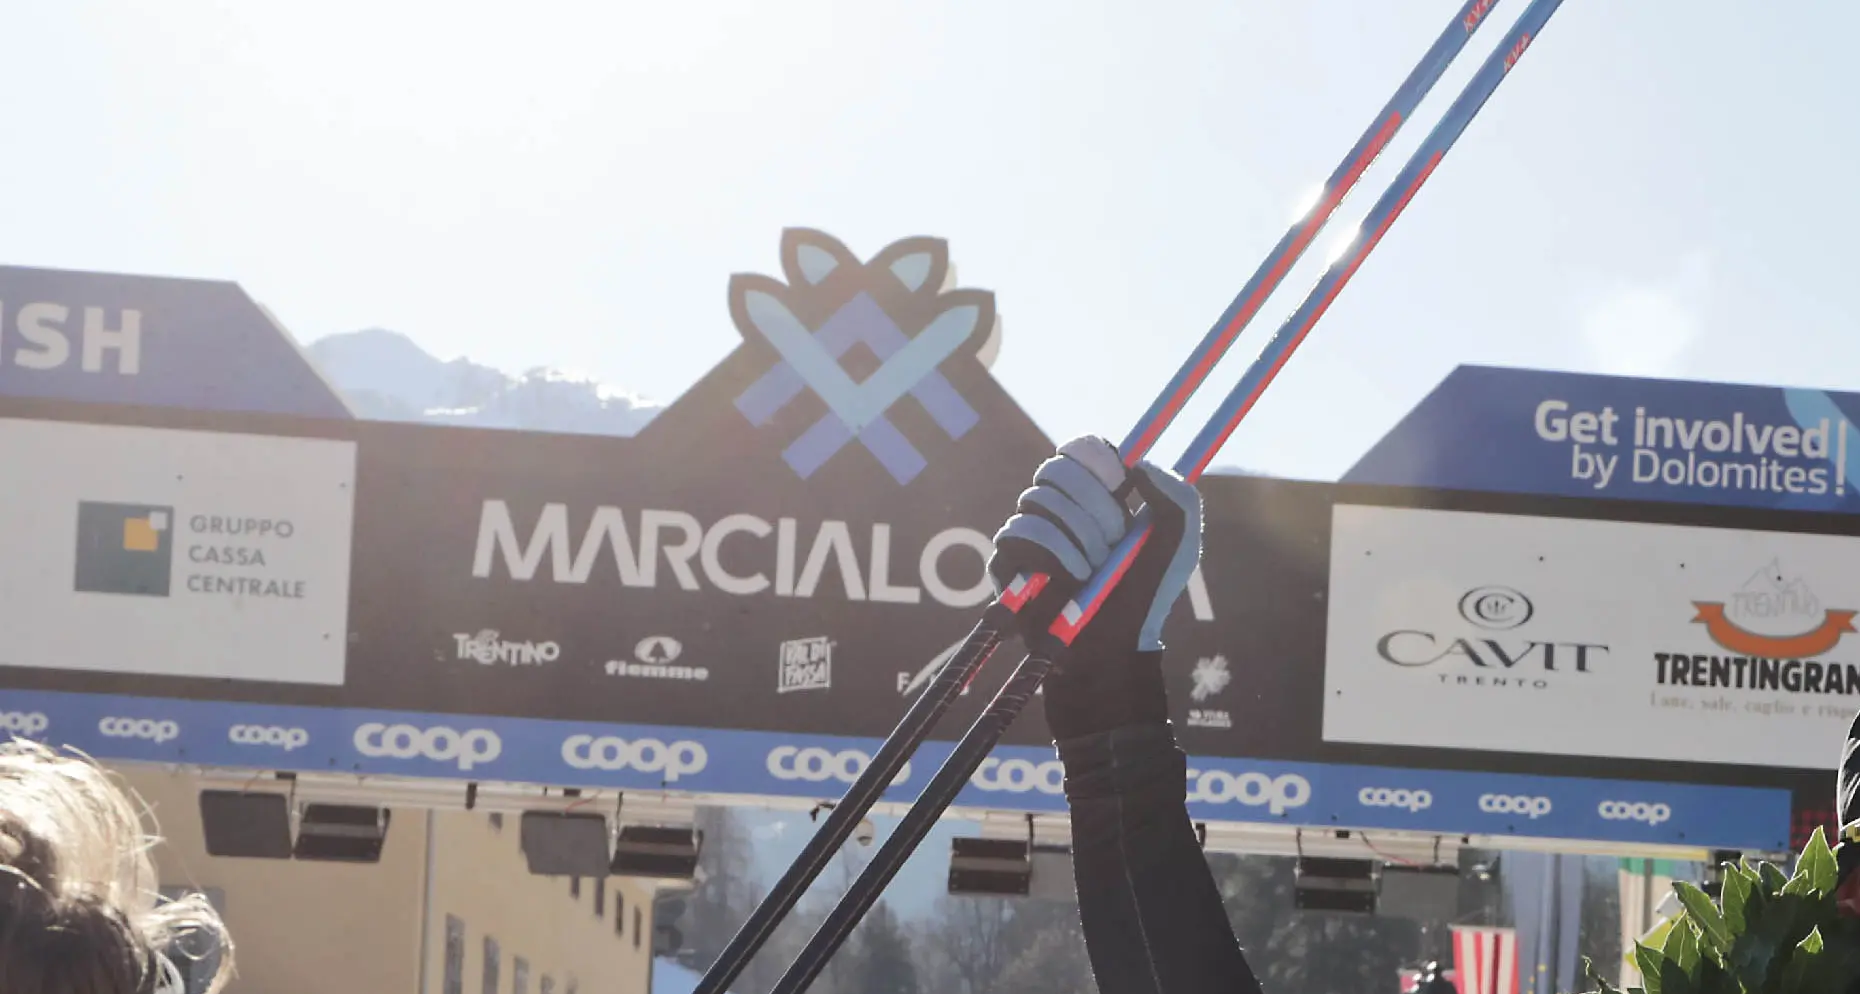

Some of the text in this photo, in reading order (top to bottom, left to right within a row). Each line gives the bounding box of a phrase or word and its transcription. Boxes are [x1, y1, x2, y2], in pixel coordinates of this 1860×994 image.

[0, 302, 141, 375] SH
[1535, 400, 1830, 459] Get involved
[1571, 443, 1616, 489] by
[189, 514, 295, 540] GRUPPO
[188, 544, 266, 567] CASSA
[187, 573, 305, 599] CENTRALE
[453, 629, 561, 667] TRENTINO
[1376, 629, 1610, 674] CAVIT
[1438, 674, 1548, 689] TRENTO
[99, 715, 179, 744] coop
[228, 724, 309, 751] coop
[352, 721, 502, 770] coop
[561, 733, 708, 782] coop
[1358, 785, 1433, 812] coop
[1478, 793, 1552, 819] coop
[1598, 799, 1671, 825] coop
